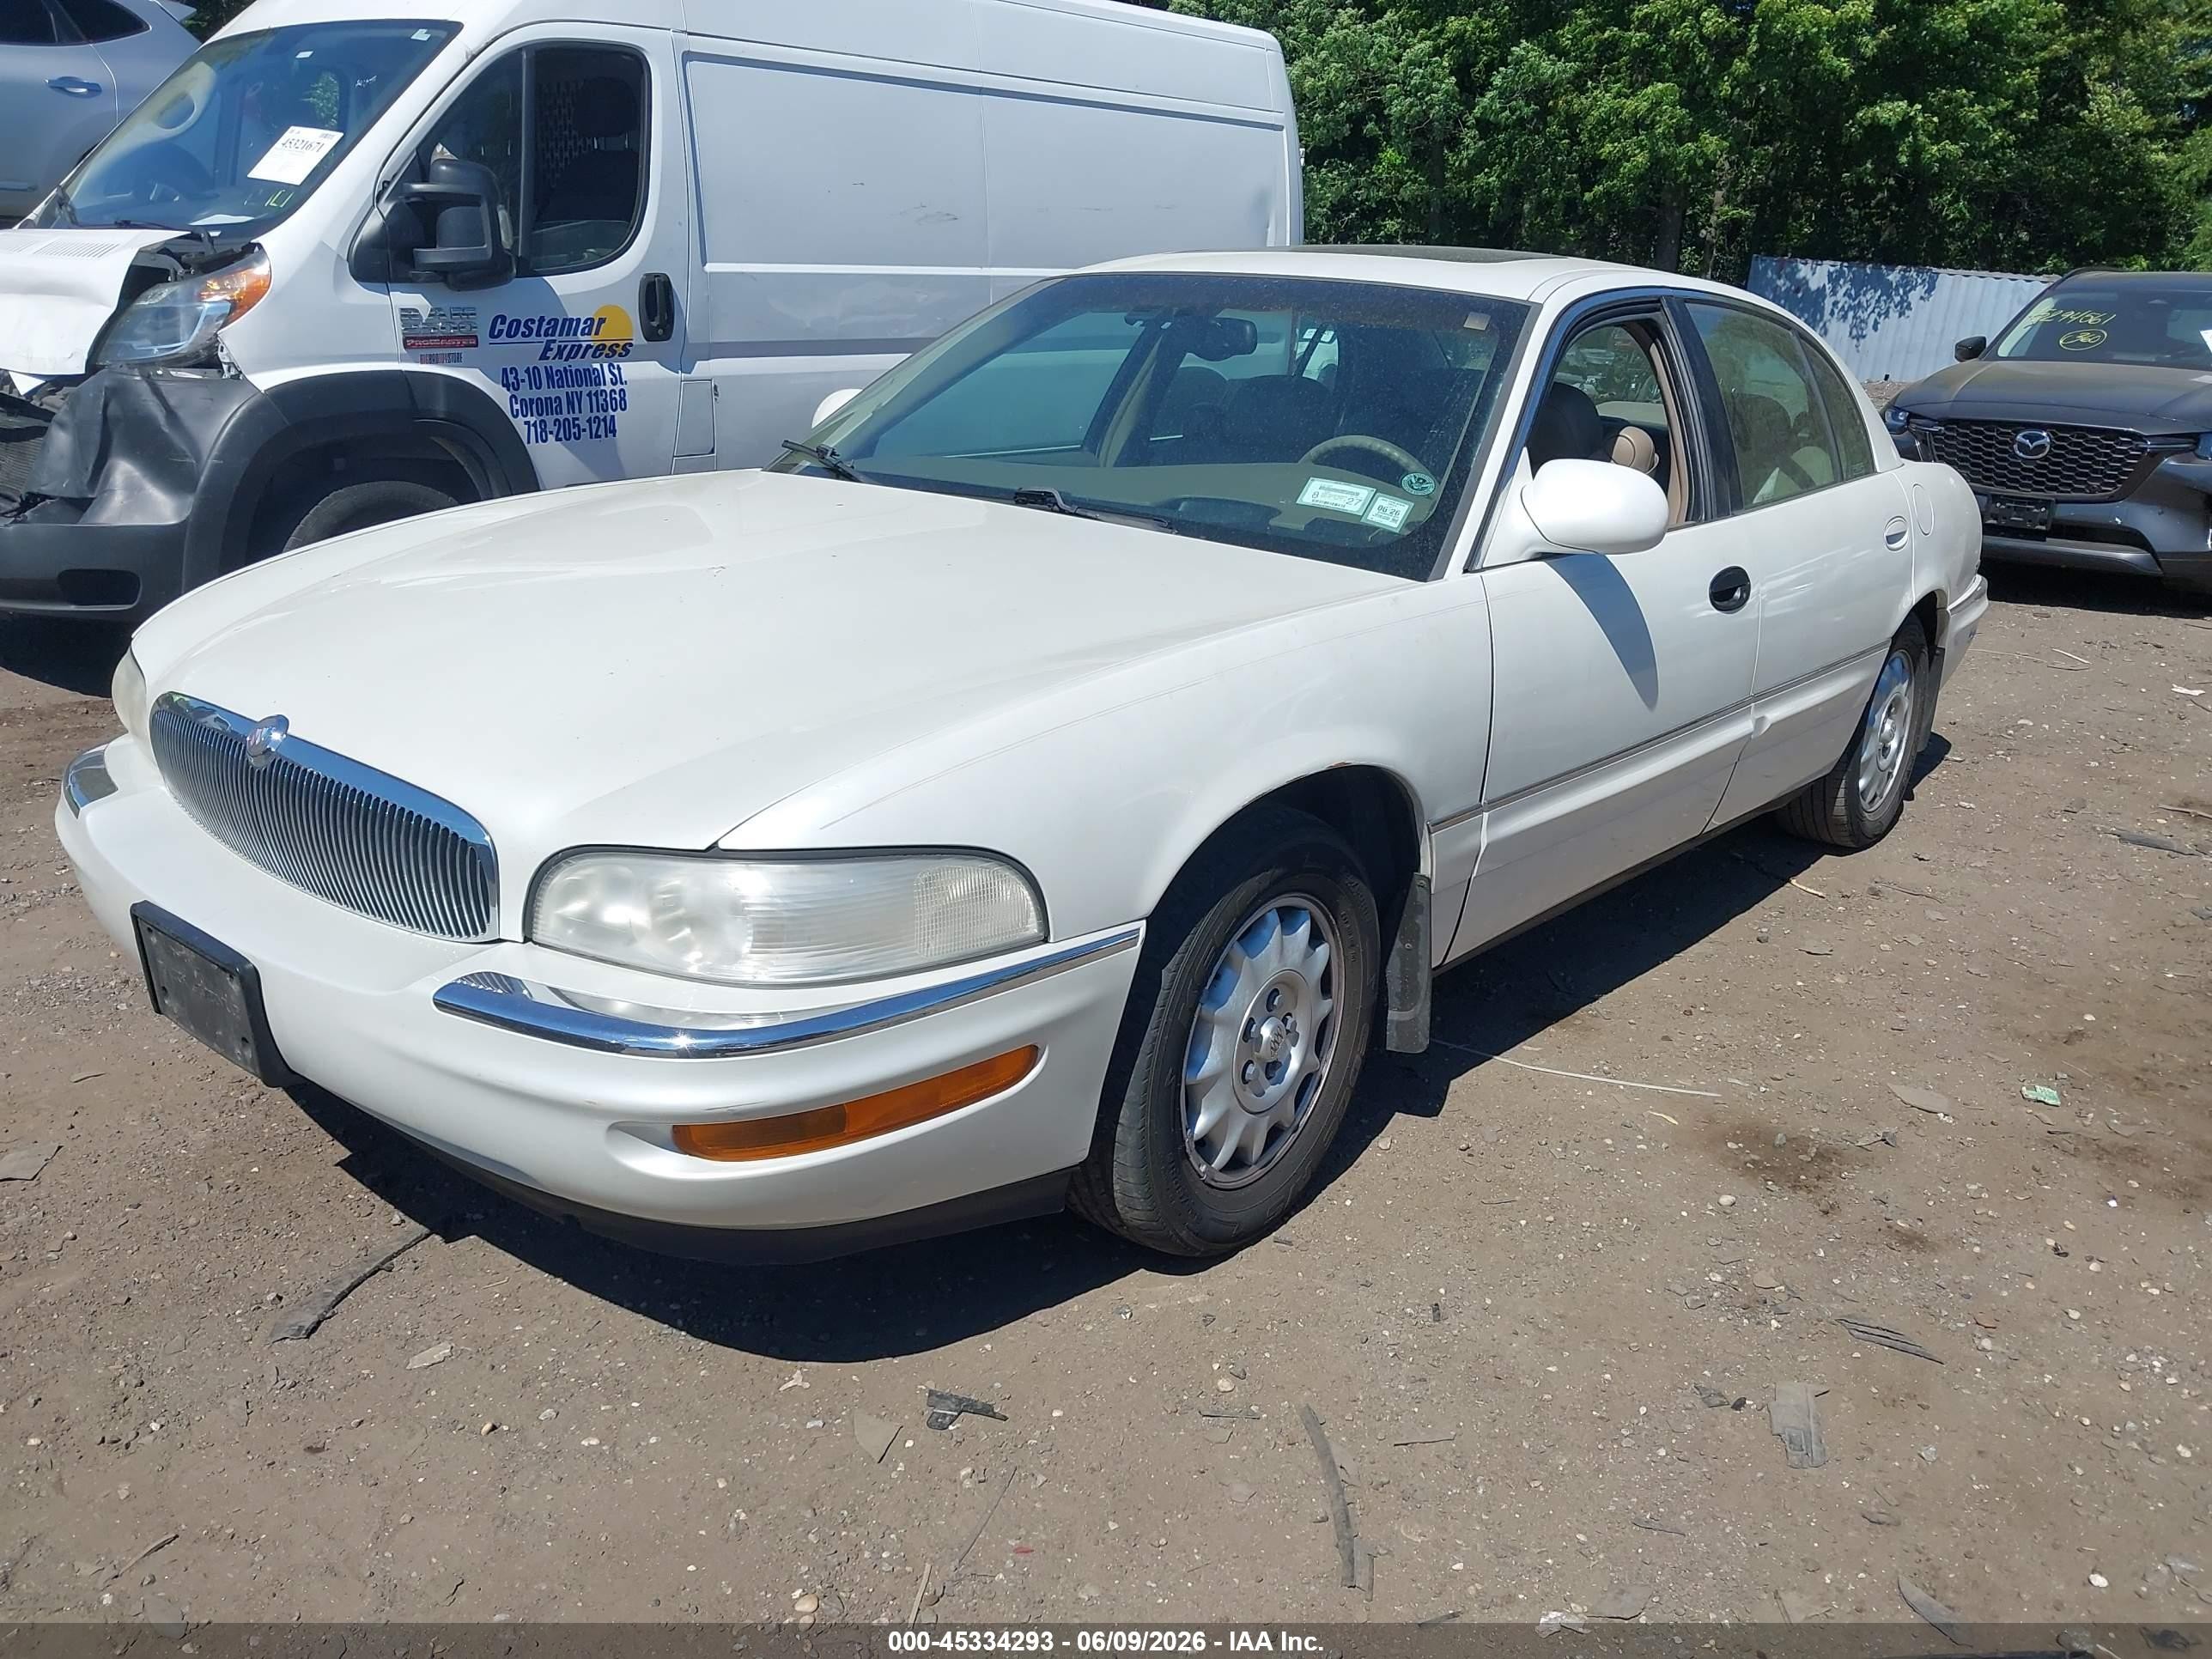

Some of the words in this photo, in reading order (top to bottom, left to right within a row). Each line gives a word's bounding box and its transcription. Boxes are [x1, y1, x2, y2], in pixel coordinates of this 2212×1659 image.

[489, 314, 606, 339] Costamar
[538, 340, 634, 362] Express
[501, 365, 543, 392] 43-10
[544, 362, 607, 390] National
[608, 362, 629, 386] St.
[508, 392, 563, 419] Corona
[563, 390, 586, 415] NY
[586, 388, 629, 413] 11368
[524, 415, 617, 445] 718-205-1214
[1346, 497, 1362, 506] 27
